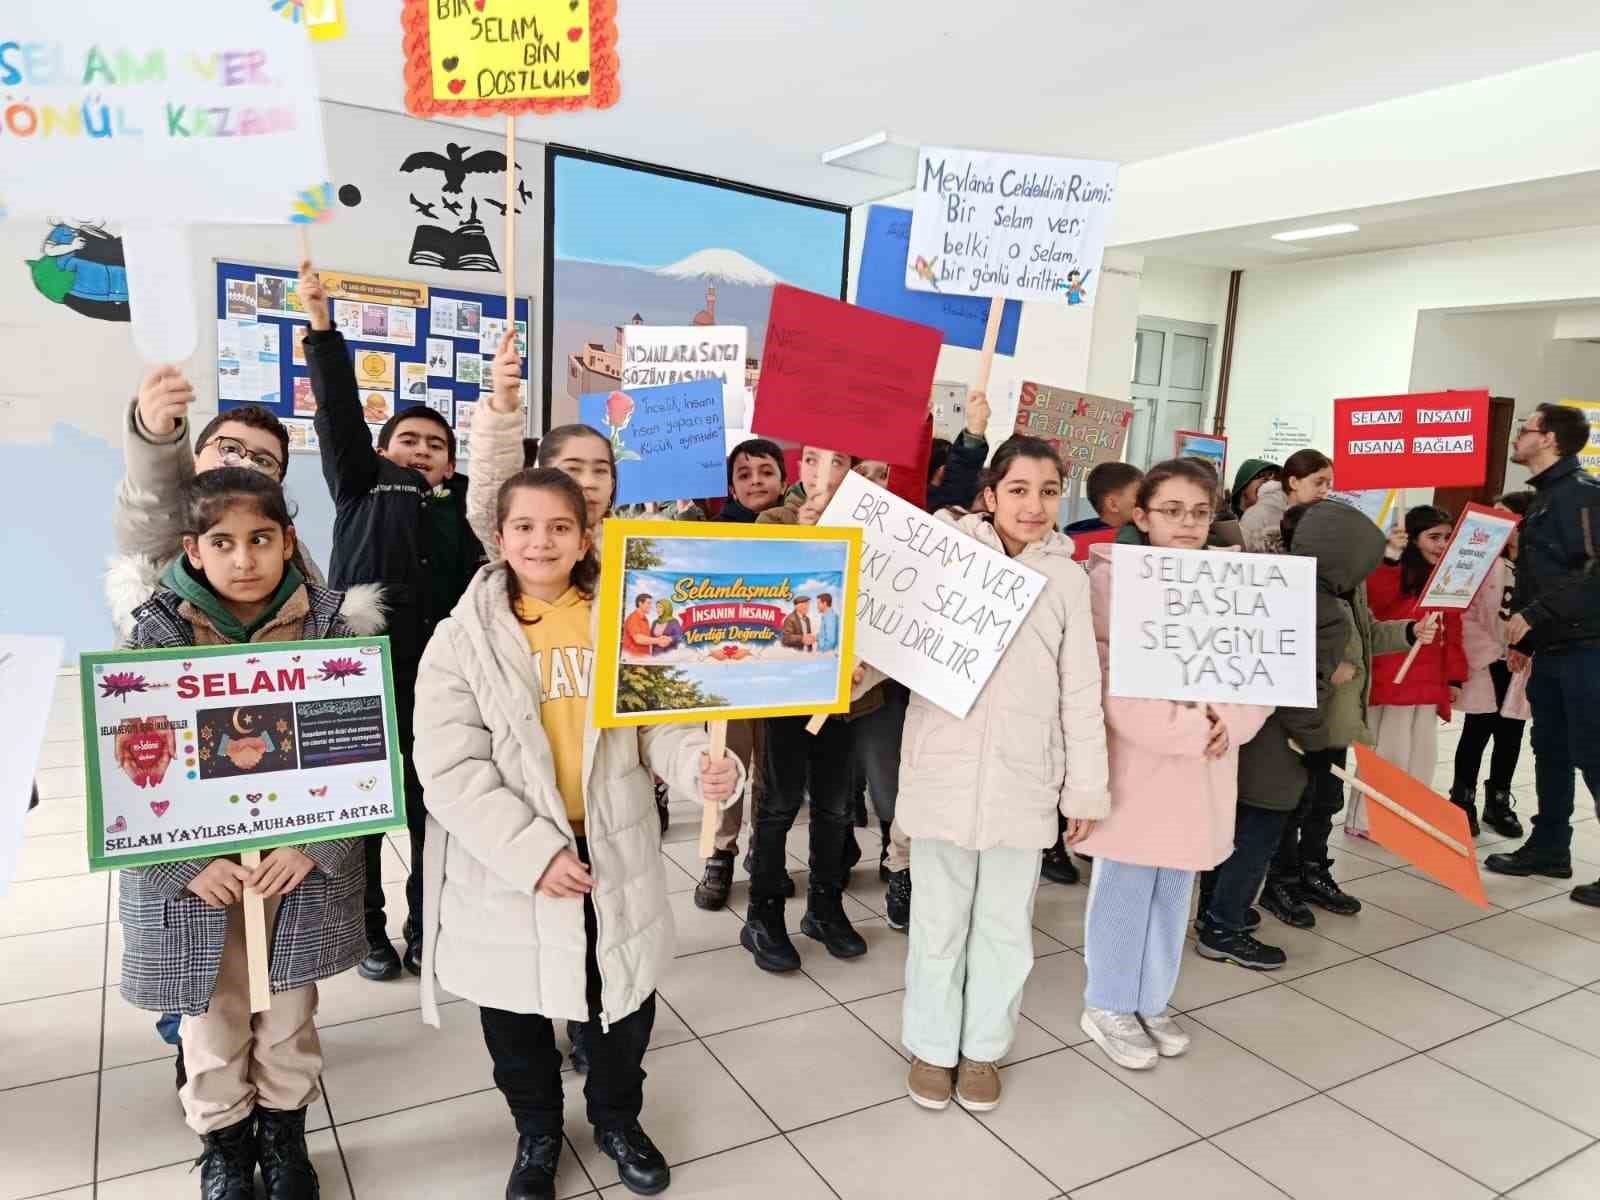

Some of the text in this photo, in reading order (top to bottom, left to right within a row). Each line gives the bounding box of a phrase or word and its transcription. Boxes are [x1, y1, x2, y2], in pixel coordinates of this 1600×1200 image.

[470, 16, 543, 43] SELAM,
[0, 42, 167, 86] SELAM
[477, 68, 576, 98] DOSTLUK
[0, 94, 144, 138] ÖNÜL
[944, 232, 990, 259] belki
[940, 259, 963, 281] bir
[969, 264, 1010, 291] gönlü
[1352, 411, 1402, 424] SELAM
[1413, 438, 1473, 453] BAĞLAR
[852, 492, 890, 533] BİR
[893, 516, 977, 579] SELAM
[1141, 554, 1288, 588] SELAMLA
[856, 587, 904, 635] ÖNLÜ
[891, 567, 918, 592] O
[921, 584, 1012, 653] SELAM,
[1166, 586, 1271, 618] BAŞLA
[1141, 620, 1297, 656] SEVGİYLE
[176, 667, 306, 699] SELAM
[1174, 653, 1275, 691] YAŞA
[105, 832, 163, 851] SELAM
[339, 803, 393, 819] ARTAR.
